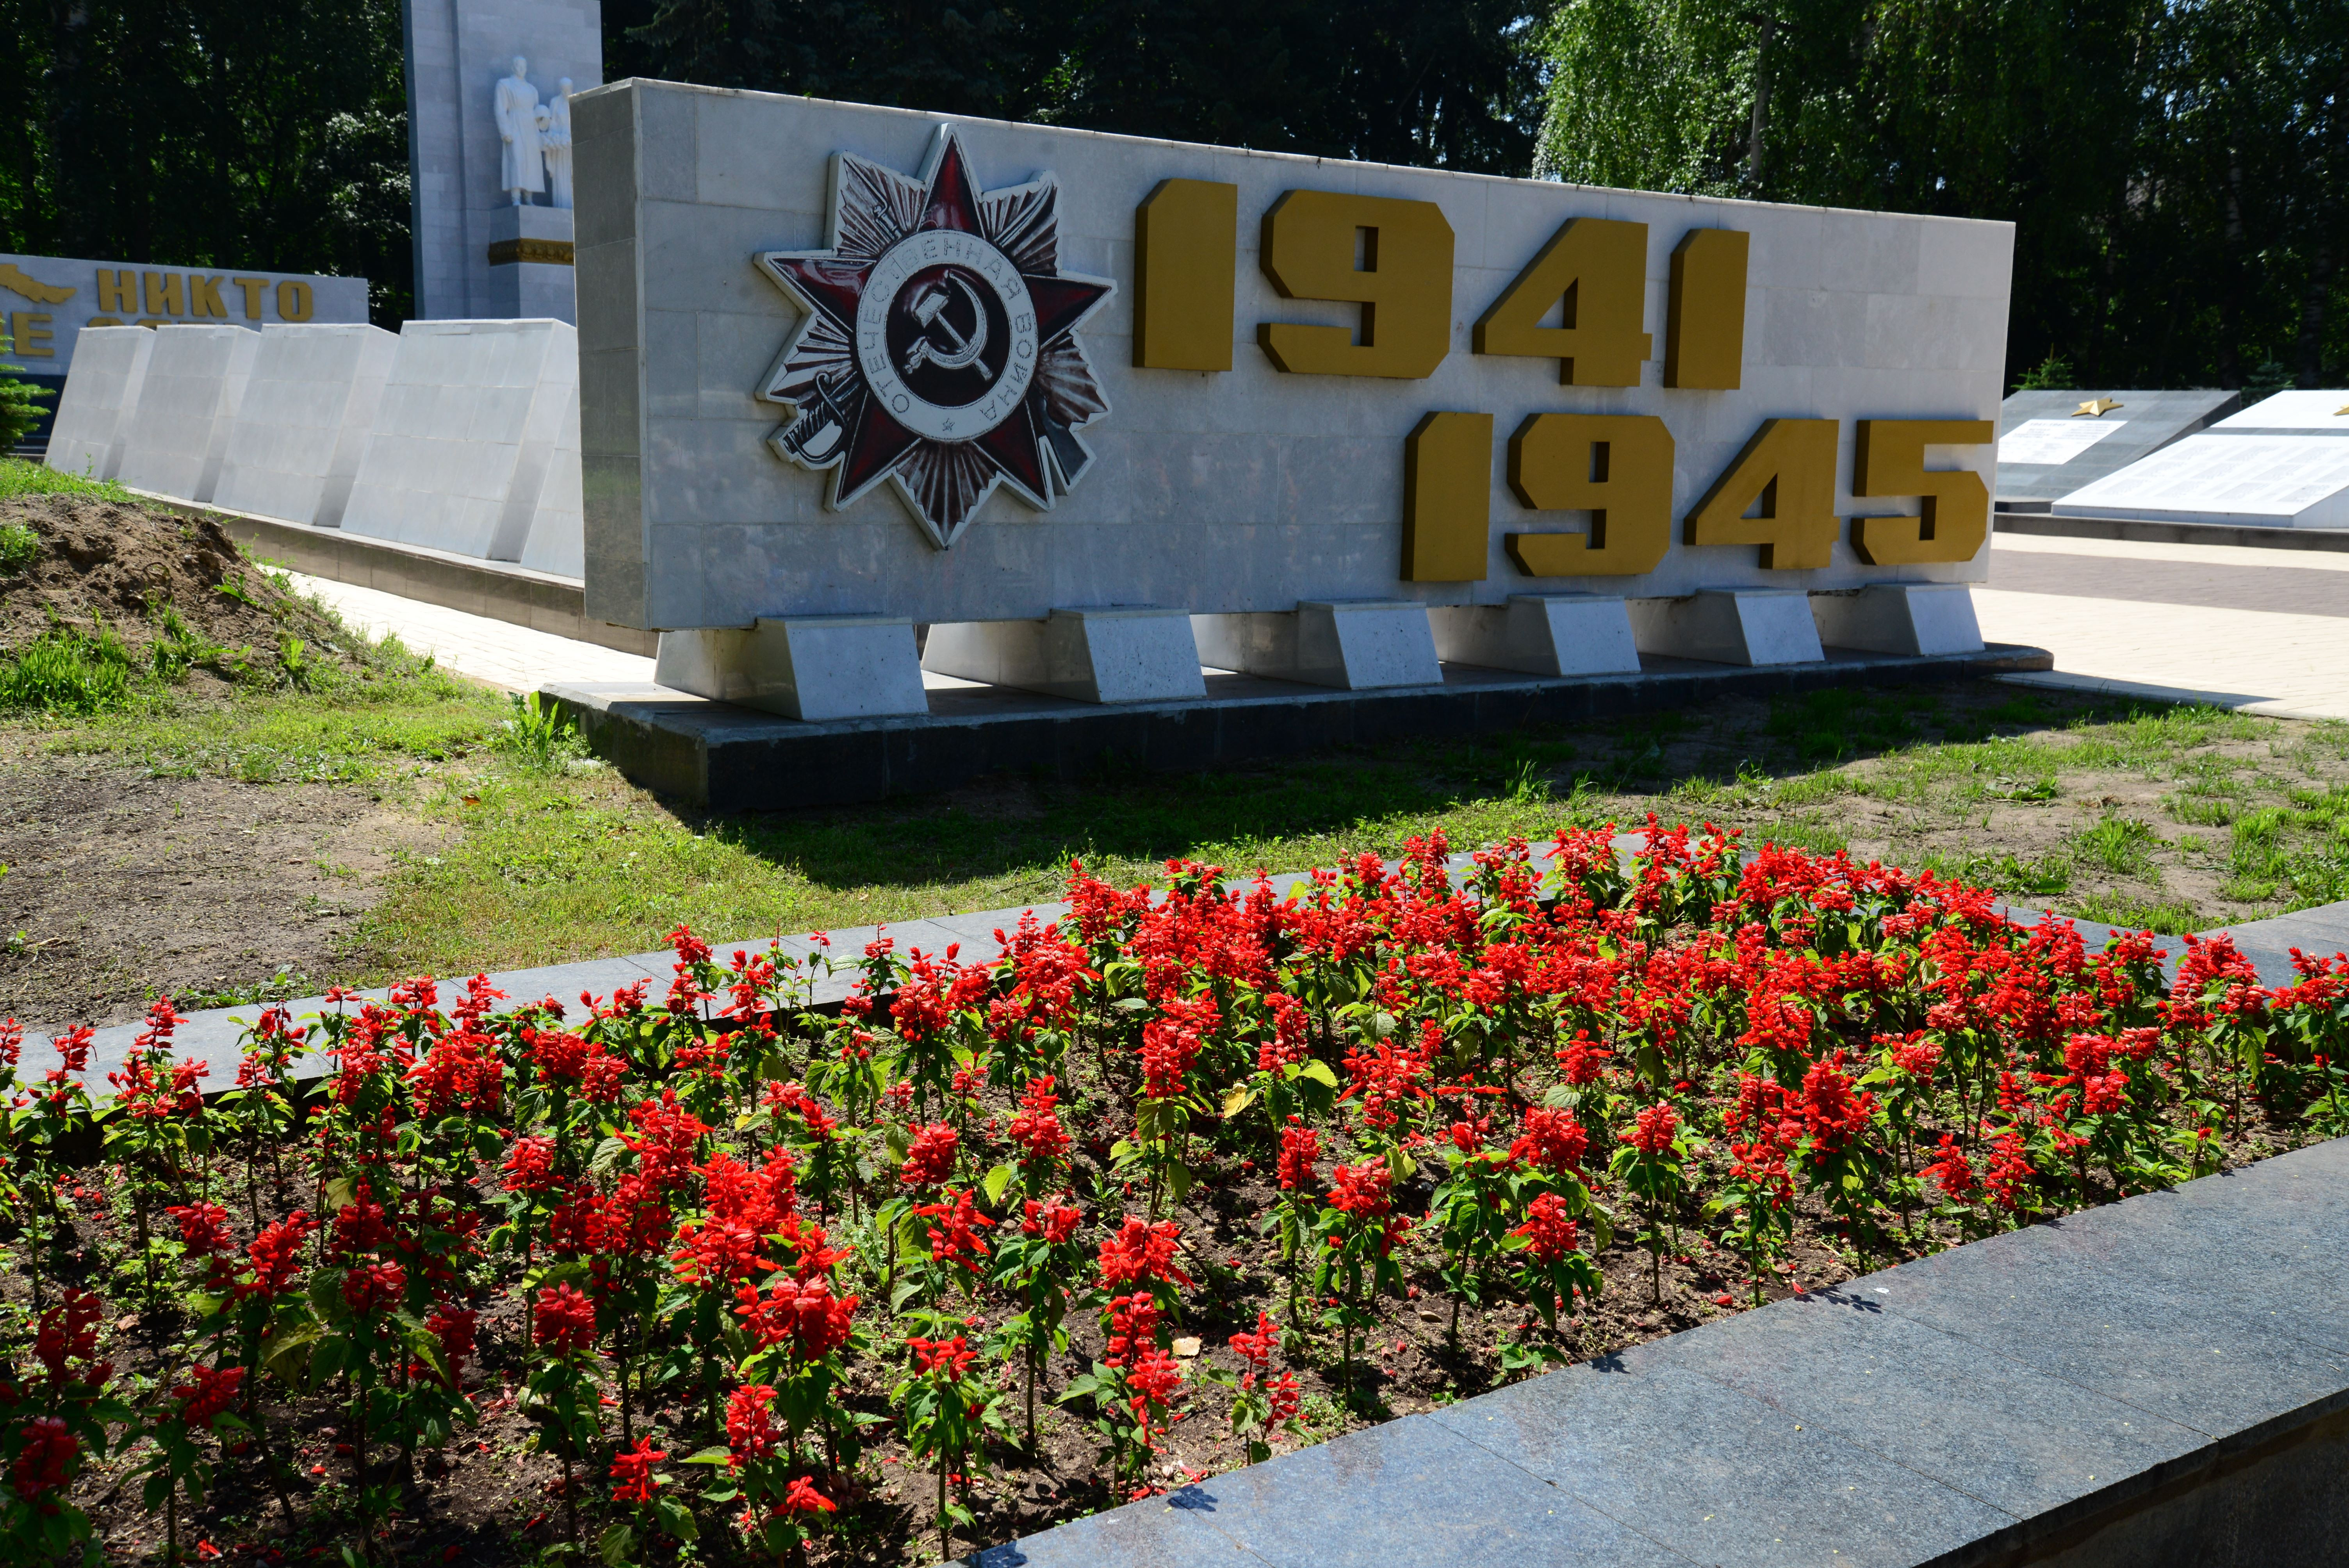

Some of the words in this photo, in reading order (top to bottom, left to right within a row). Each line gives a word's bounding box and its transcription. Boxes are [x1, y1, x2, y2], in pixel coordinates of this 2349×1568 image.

[97, 268, 312, 322] НИКТО
[864, 237, 1022, 413] ОТЕЧЕСТВЕННАЯ
[979, 312, 1032, 421] ВОЙНА
[1132, 178, 1749, 389] 1941
[1399, 411, 1994, 582] 1945
